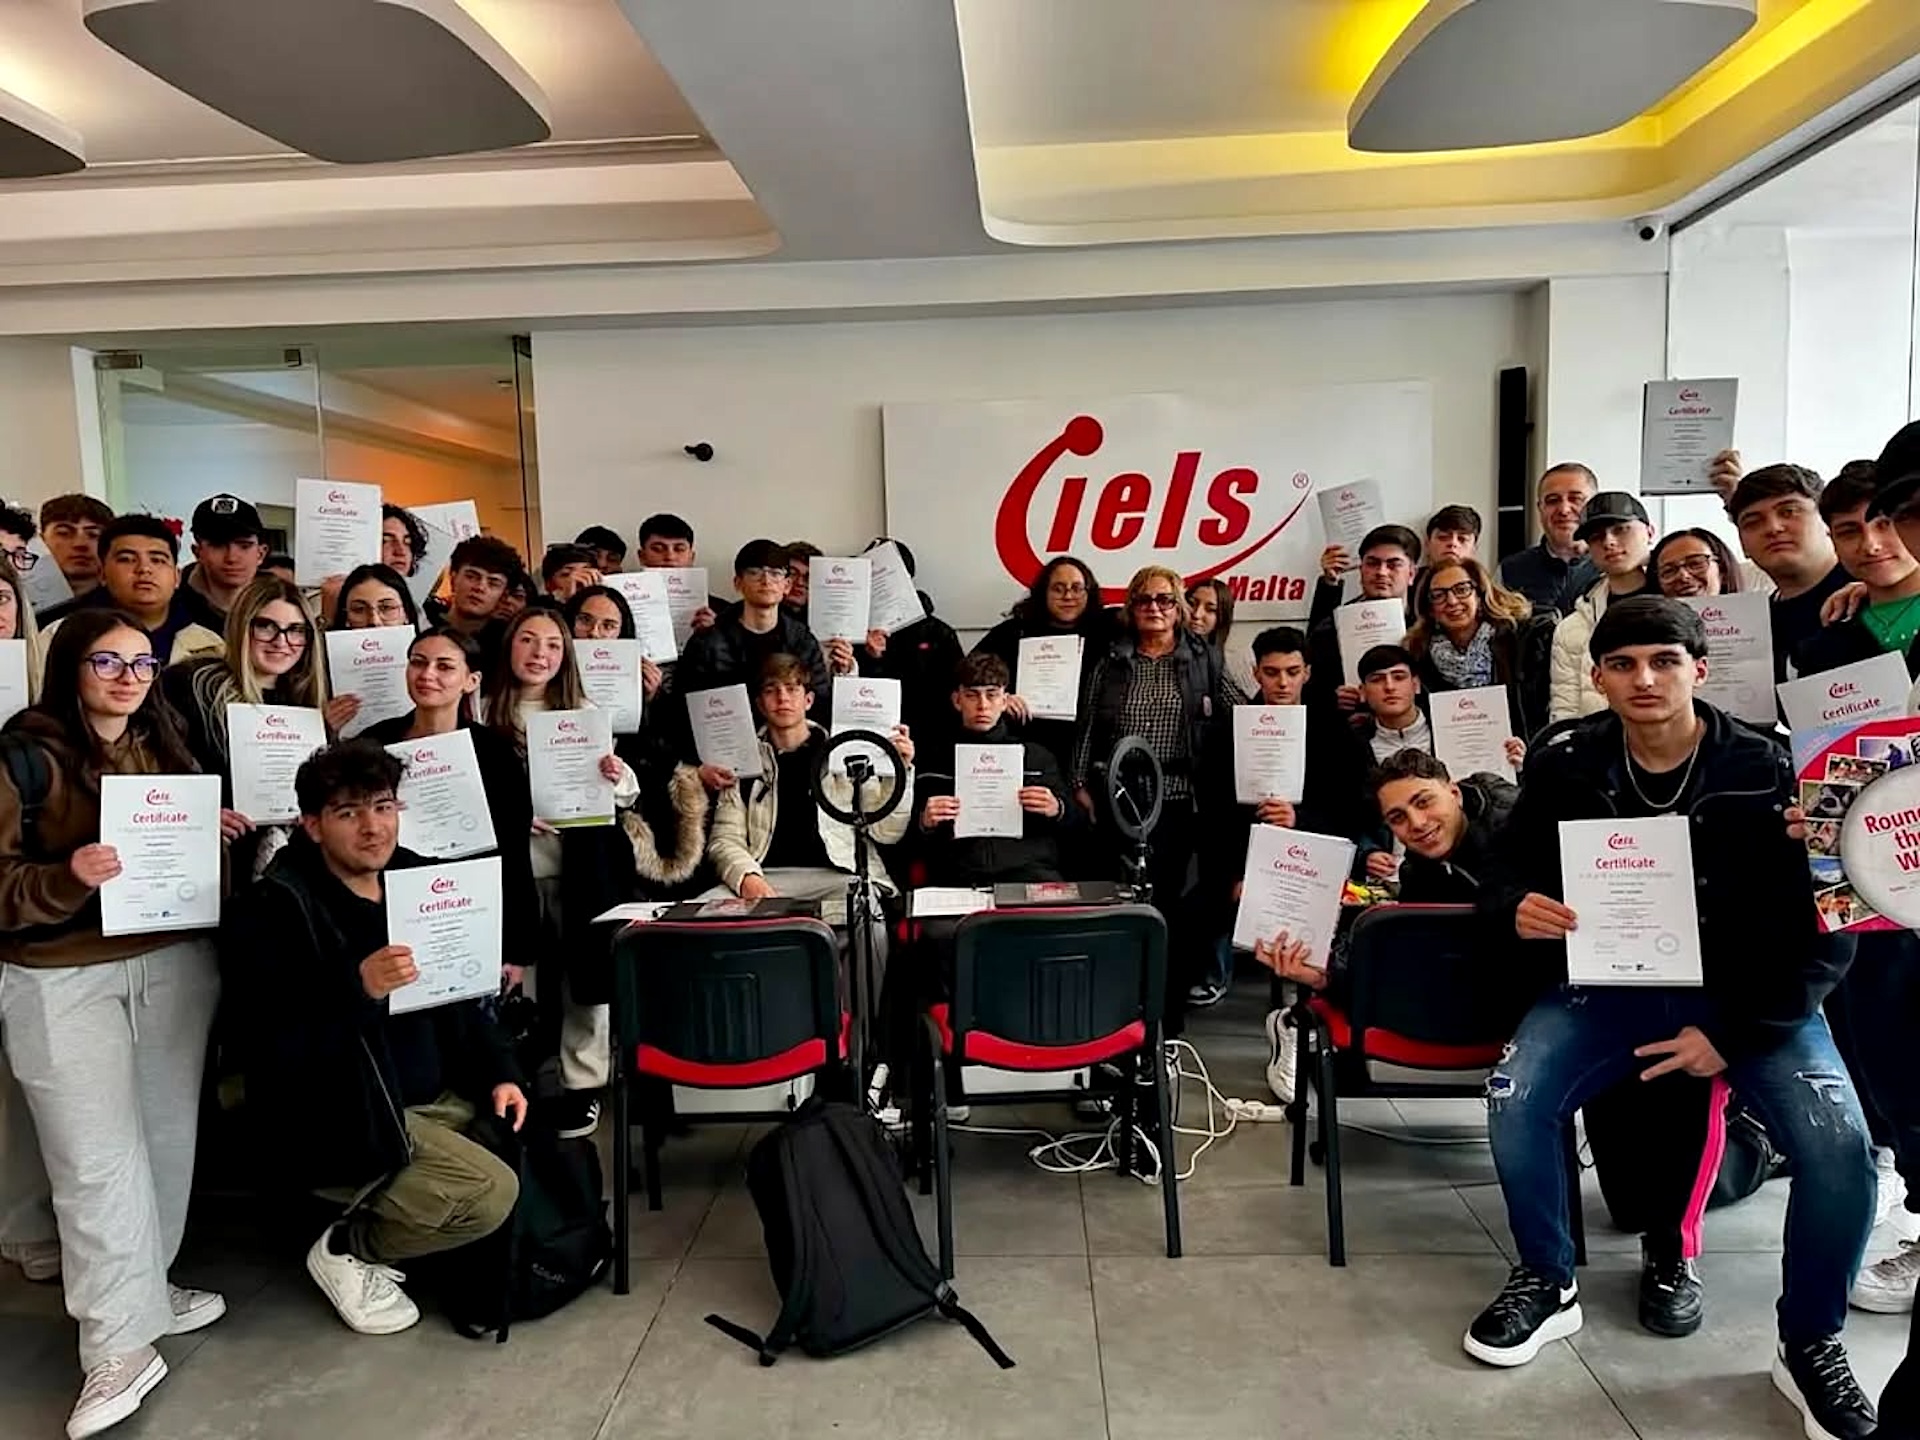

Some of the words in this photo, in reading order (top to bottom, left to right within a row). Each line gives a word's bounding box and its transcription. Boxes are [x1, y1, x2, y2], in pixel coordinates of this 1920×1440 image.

[1228, 575, 1305, 601] Malta
[353, 655, 394, 666] Certificate
[1823, 698, 1880, 720] Certificate
[256, 731, 301, 741] Certificate
[132, 812, 188, 824] Certificate
[1864, 807, 1920, 834] Roun
[1894, 829, 1920, 850] th
[1273, 860, 1319, 878] Certificate
[1595, 858, 1656, 870] Certificate
[419, 898, 472, 914] Certificate
